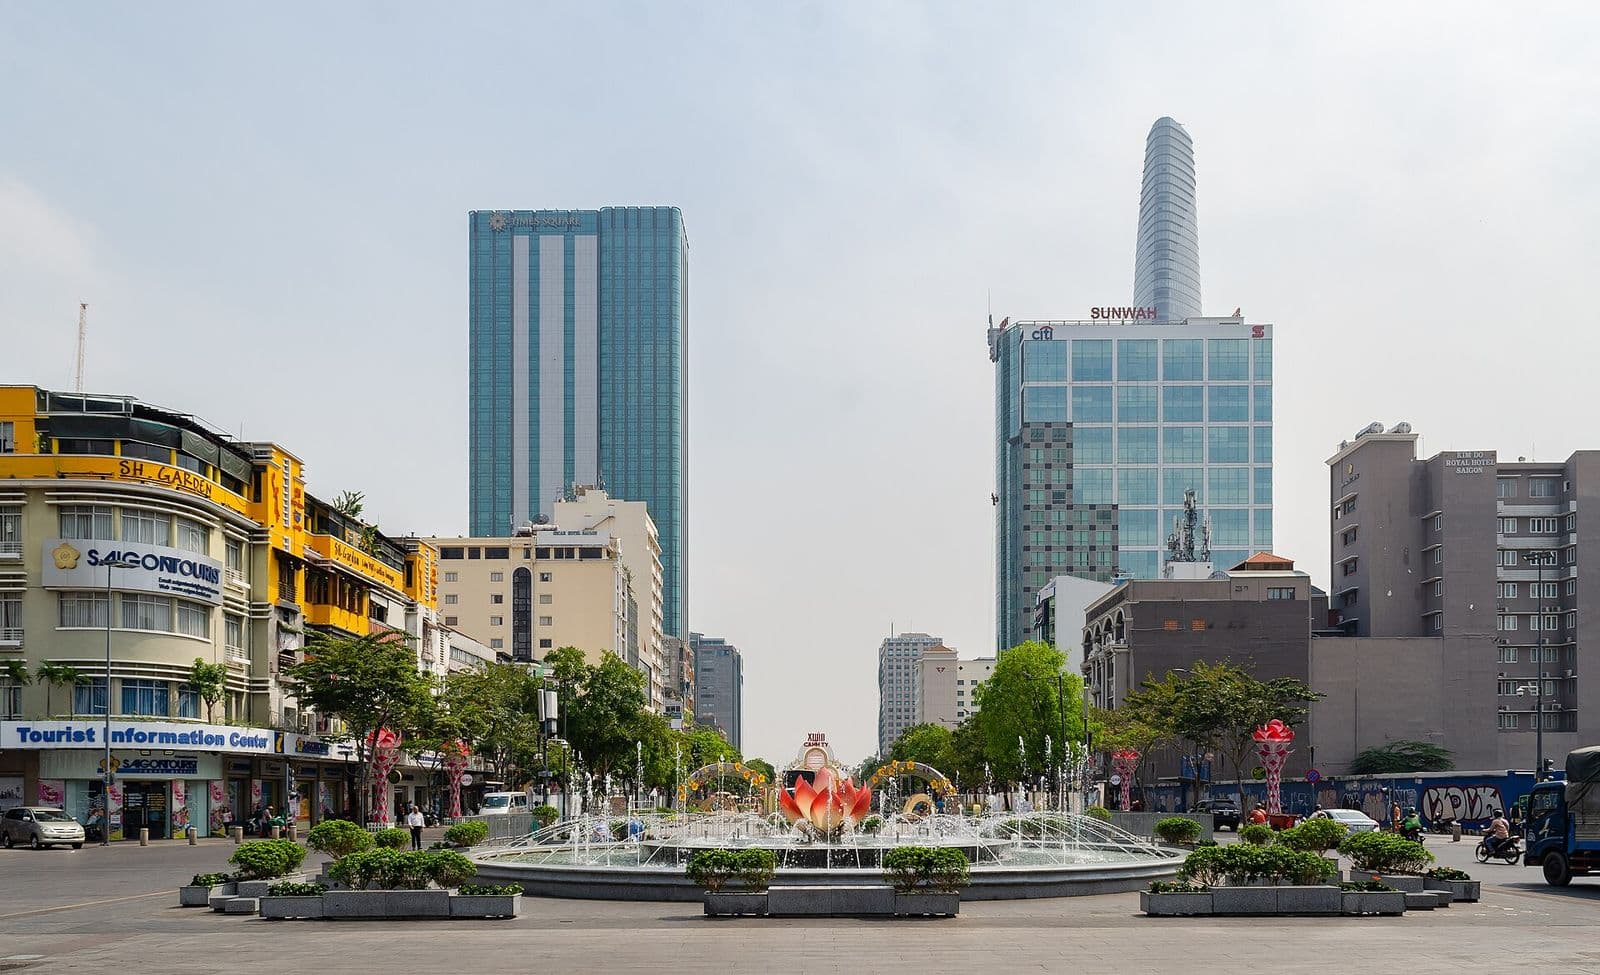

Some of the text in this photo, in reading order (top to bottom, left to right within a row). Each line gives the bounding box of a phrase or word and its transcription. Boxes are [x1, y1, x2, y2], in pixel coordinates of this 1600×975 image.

[543, 216, 580, 228] SQUARE
[1090, 307, 1158, 319] SUNWAH
[1032, 326, 1053, 341] citi
[158, 467, 212, 496] GARDEN
[87, 549, 220, 584] SAIGONTOURIST
[17, 726, 95, 743] Tourist
[229, 732, 269, 749] Center
